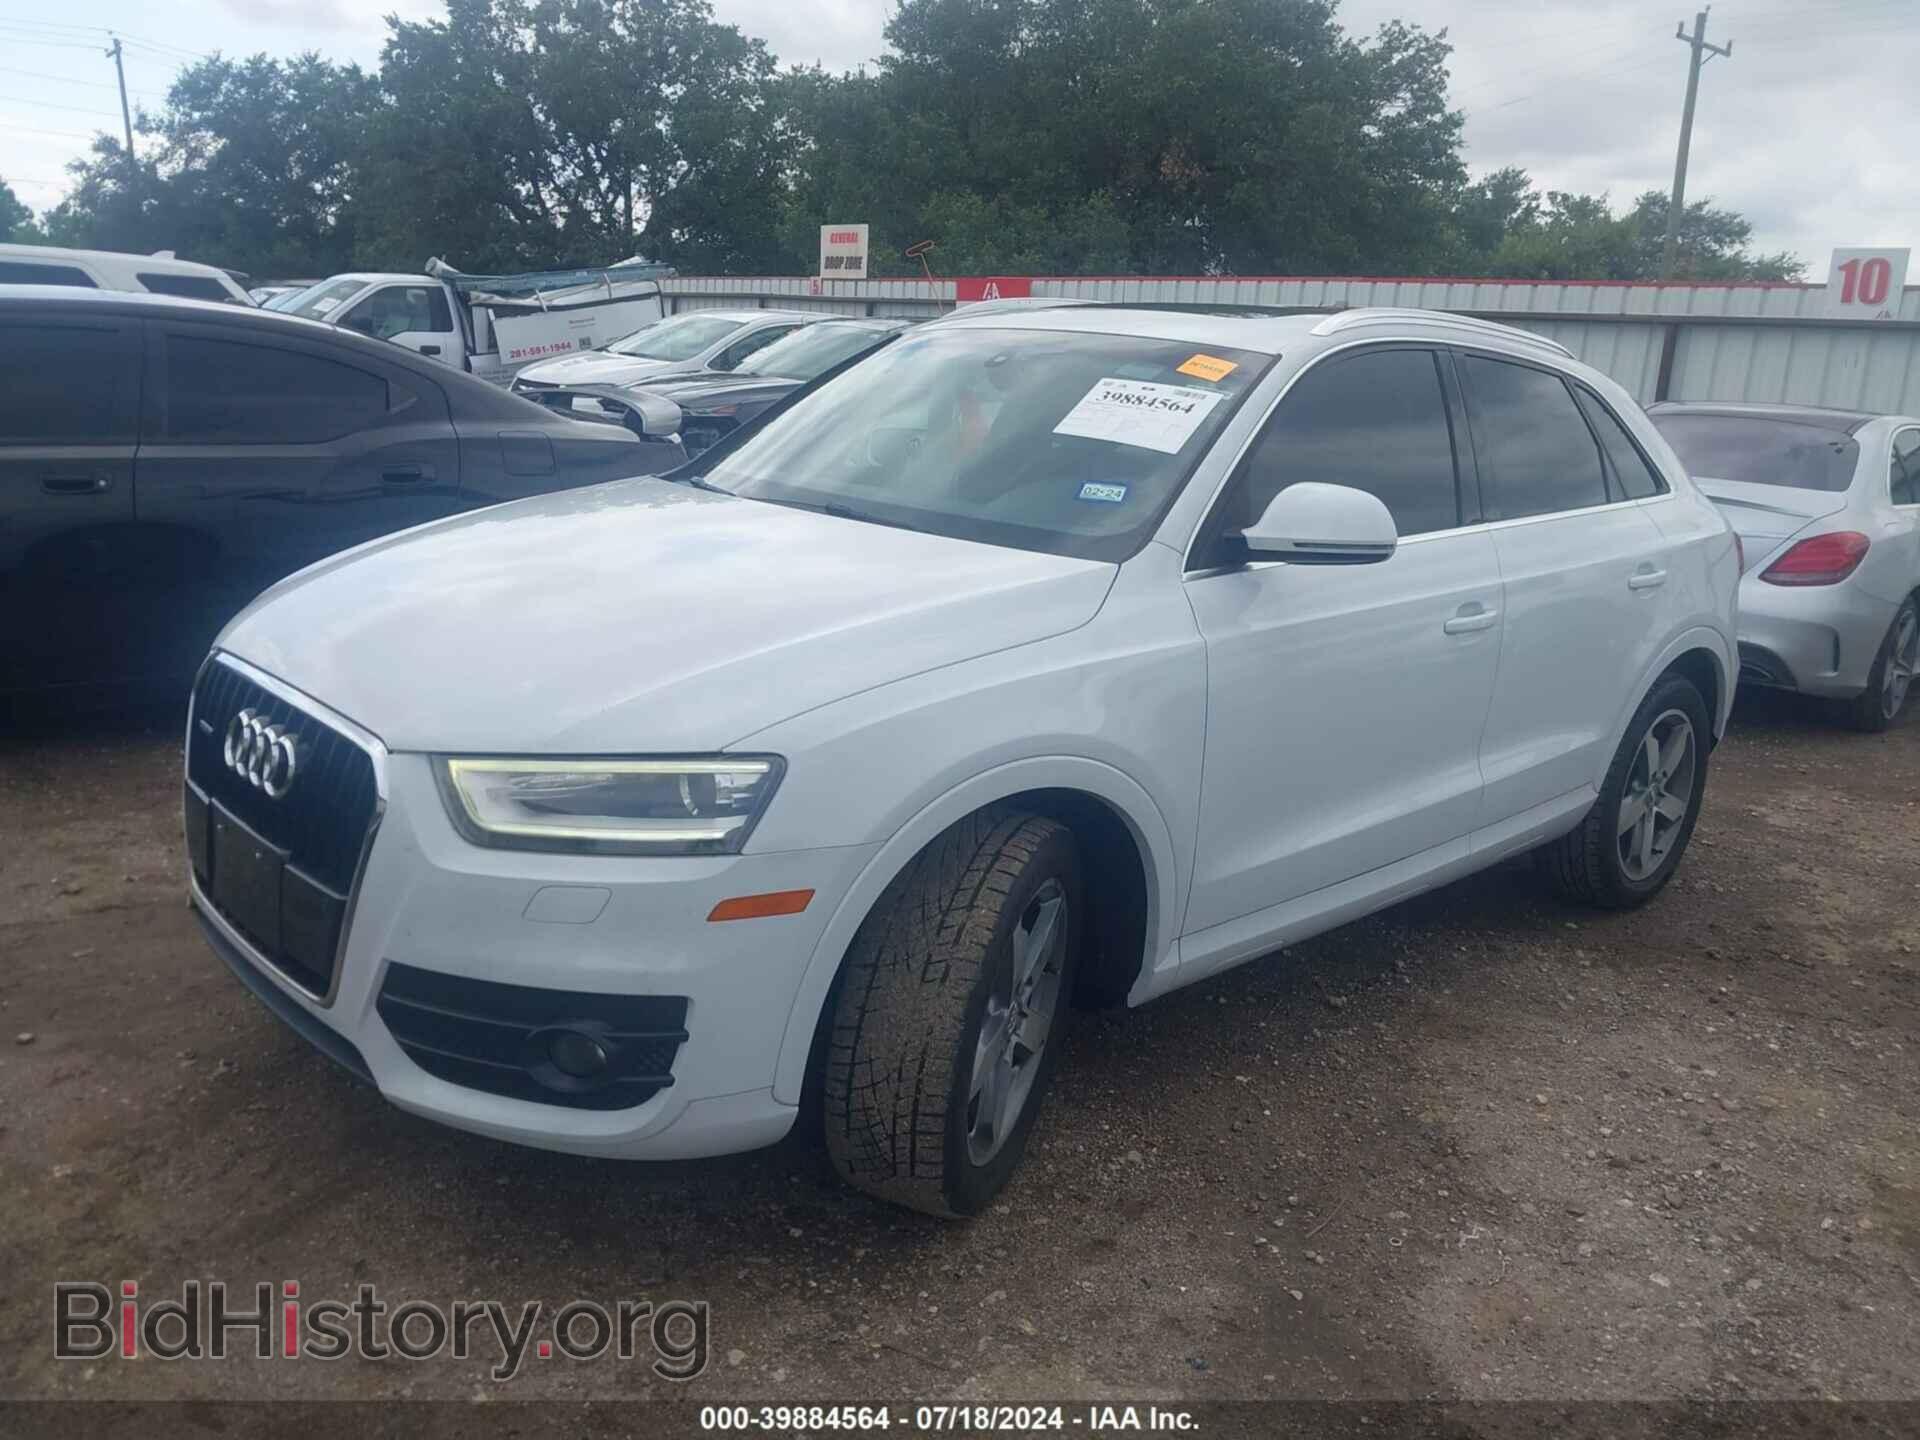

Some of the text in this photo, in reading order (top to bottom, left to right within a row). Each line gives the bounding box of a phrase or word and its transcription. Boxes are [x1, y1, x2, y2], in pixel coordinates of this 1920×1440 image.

[824, 256, 863, 269] DROP ZONE
[1838, 258, 1889, 304] 10
[1096, 390, 1196, 414] 39884564
